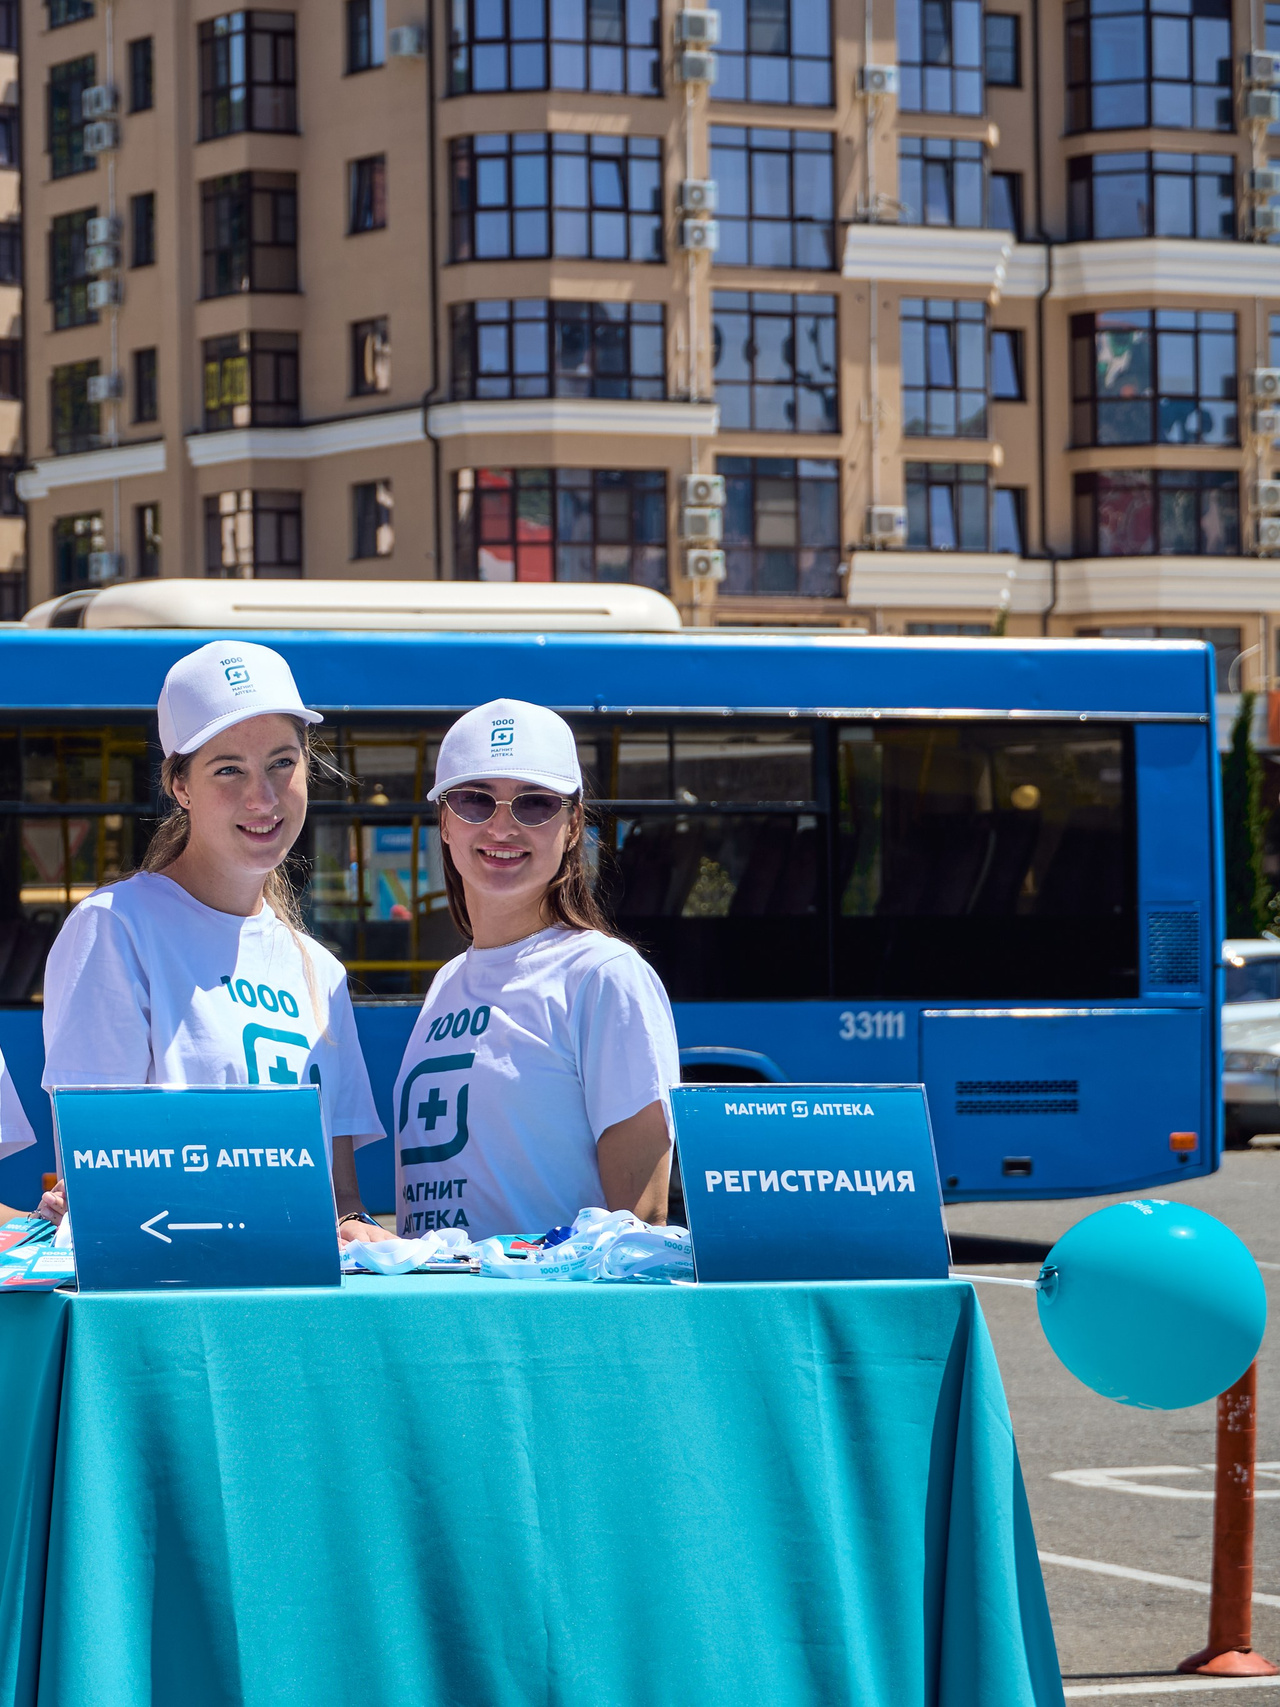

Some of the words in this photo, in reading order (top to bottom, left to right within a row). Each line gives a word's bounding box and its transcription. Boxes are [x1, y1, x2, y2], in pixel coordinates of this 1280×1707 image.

[220, 656, 243, 666] 1000
[491, 718, 515, 727] 1000
[220, 975, 300, 1018] 1000
[425, 1005, 491, 1044] 1000
[839, 1010, 905, 1040] 33111
[724, 1102, 787, 1116] МАГНИТ
[813, 1103, 875, 1116] АПТЕКА
[73, 1149, 175, 1169] МАГНИТ
[216, 1148, 315, 1168] АПТЕКА
[705, 1169, 916, 1196] РЕГИСТРАЦИЯ
[403, 1208, 470, 1235] АПТЕКА
[663, 1240, 684, 1251] 1000
[540, 1266, 560, 1275] 1000
